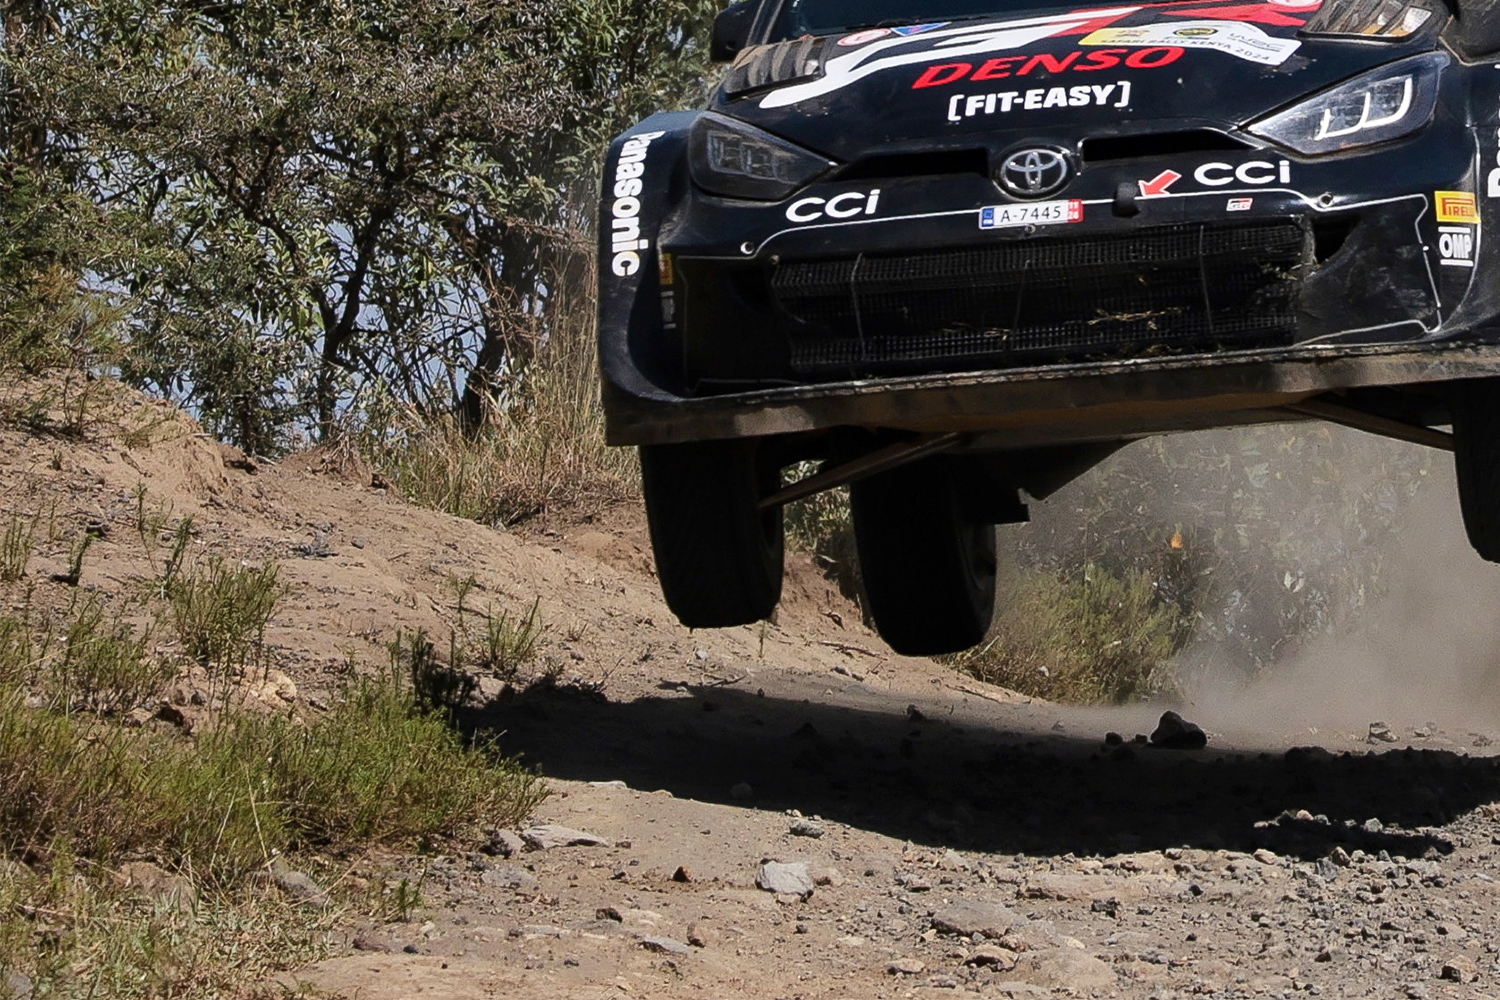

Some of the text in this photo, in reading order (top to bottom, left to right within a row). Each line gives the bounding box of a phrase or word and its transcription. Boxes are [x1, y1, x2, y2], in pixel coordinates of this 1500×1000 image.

[1235, 48, 1270, 60] 2024
[912, 46, 1185, 89] DENSO
[612, 131, 666, 277] Panasonic
[1000, 205, 1061, 222] A-7445
[1442, 198, 1475, 217] PIRELL
[1439, 233, 1472, 258] OMP
